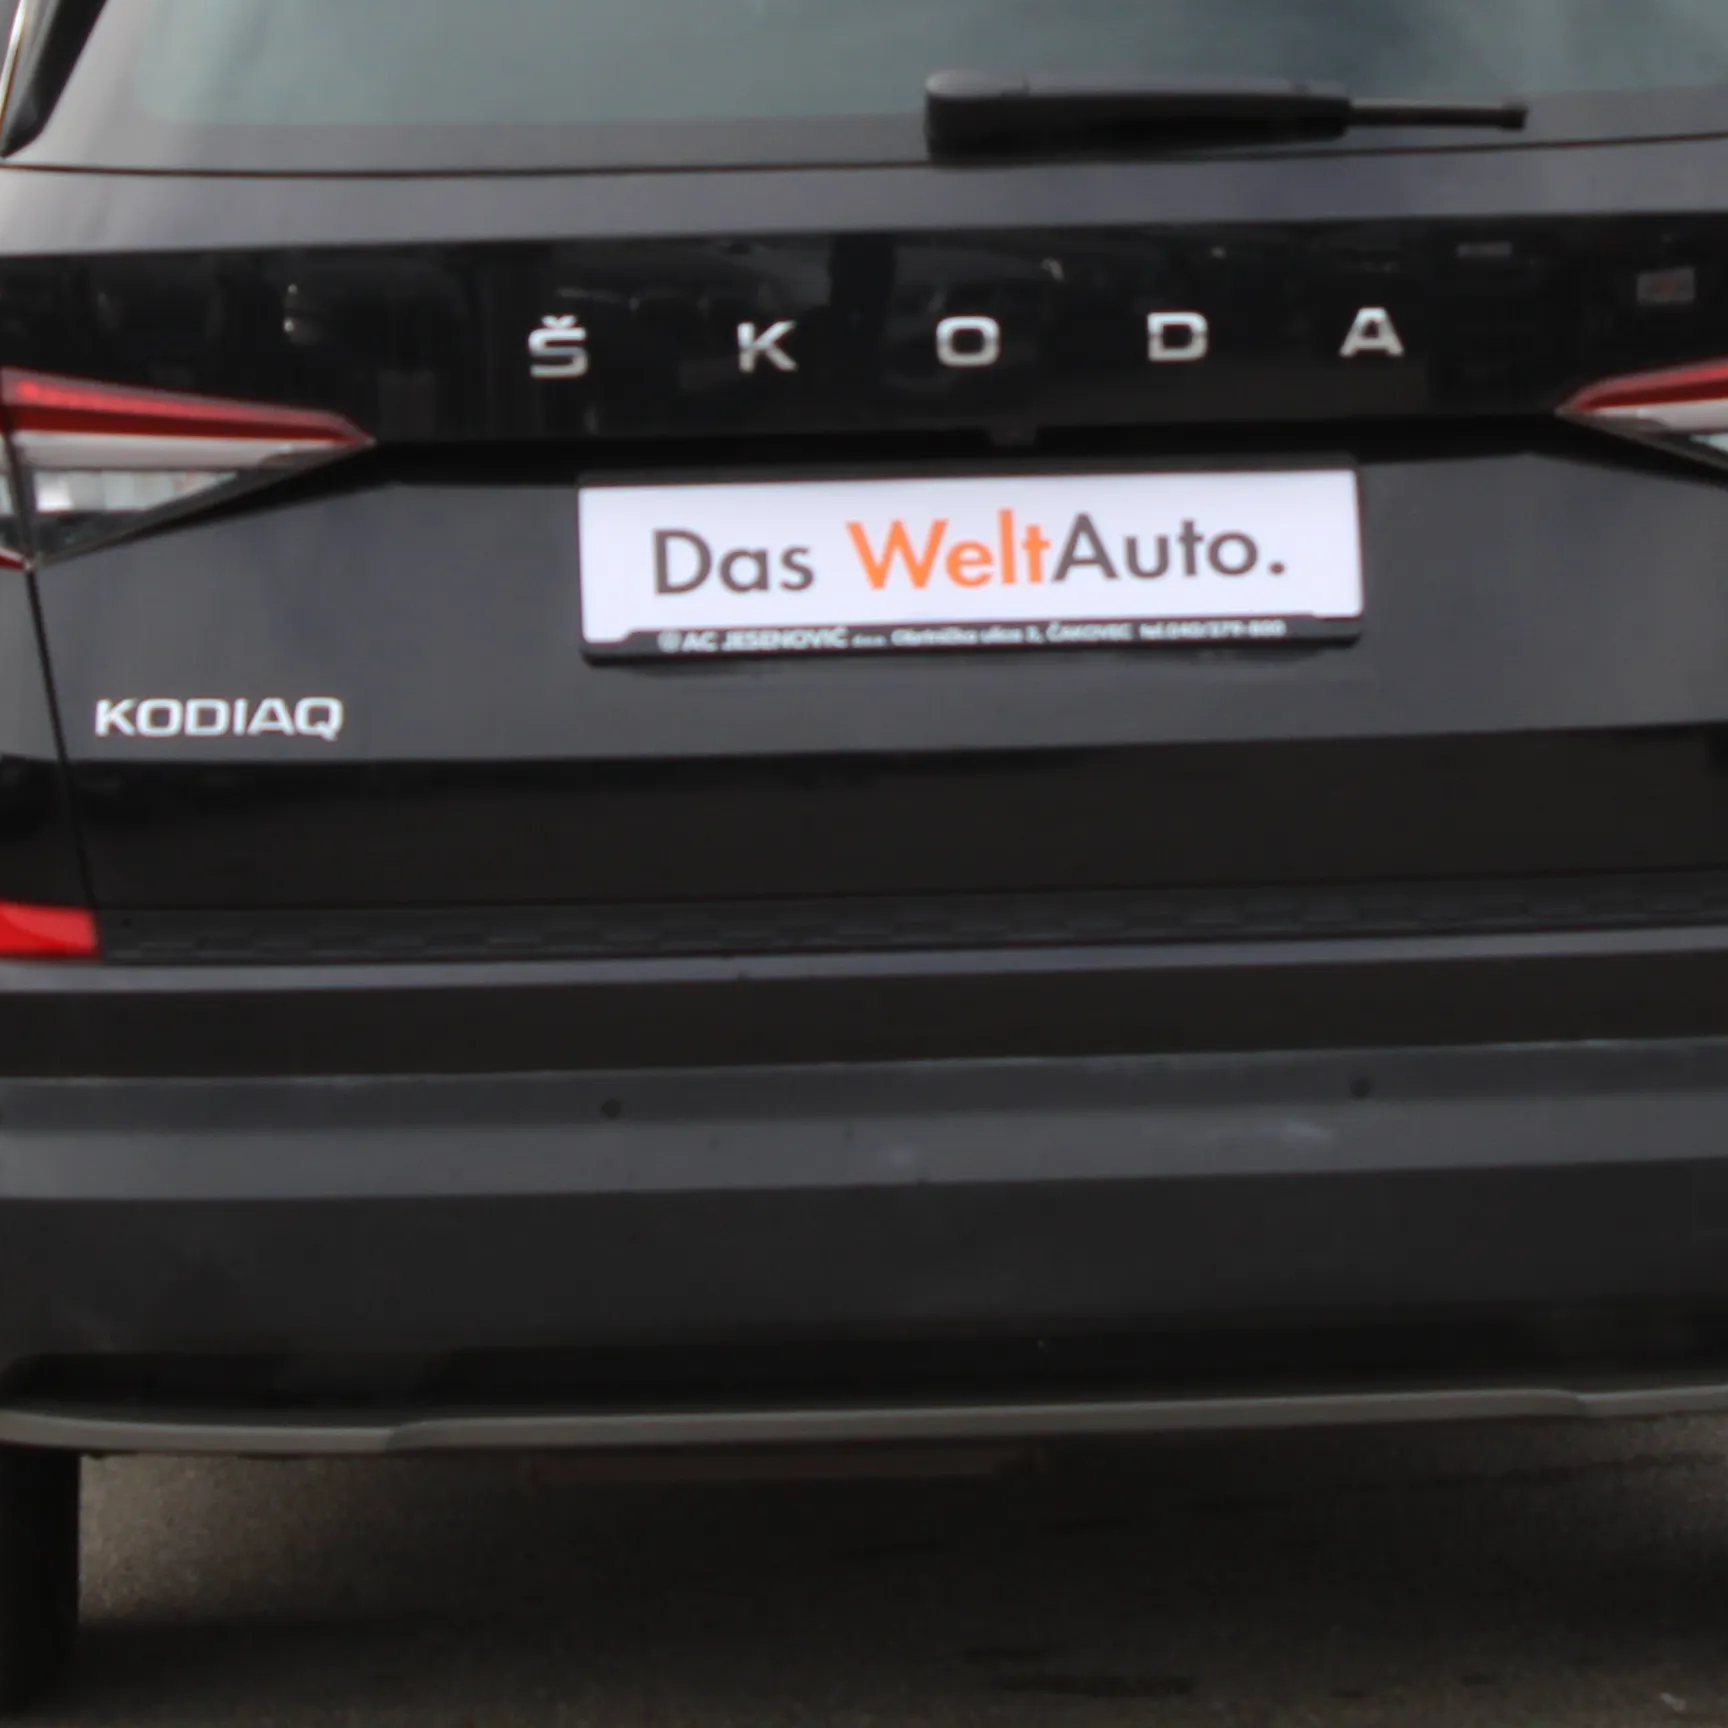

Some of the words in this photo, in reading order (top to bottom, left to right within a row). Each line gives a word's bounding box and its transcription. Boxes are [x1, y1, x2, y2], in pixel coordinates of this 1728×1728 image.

[528, 308, 1403, 377] ŠKODA
[654, 529, 814, 595] Das
[848, 509, 1286, 589] WeltAuto.
[95, 697, 343, 741] KODIAQ
